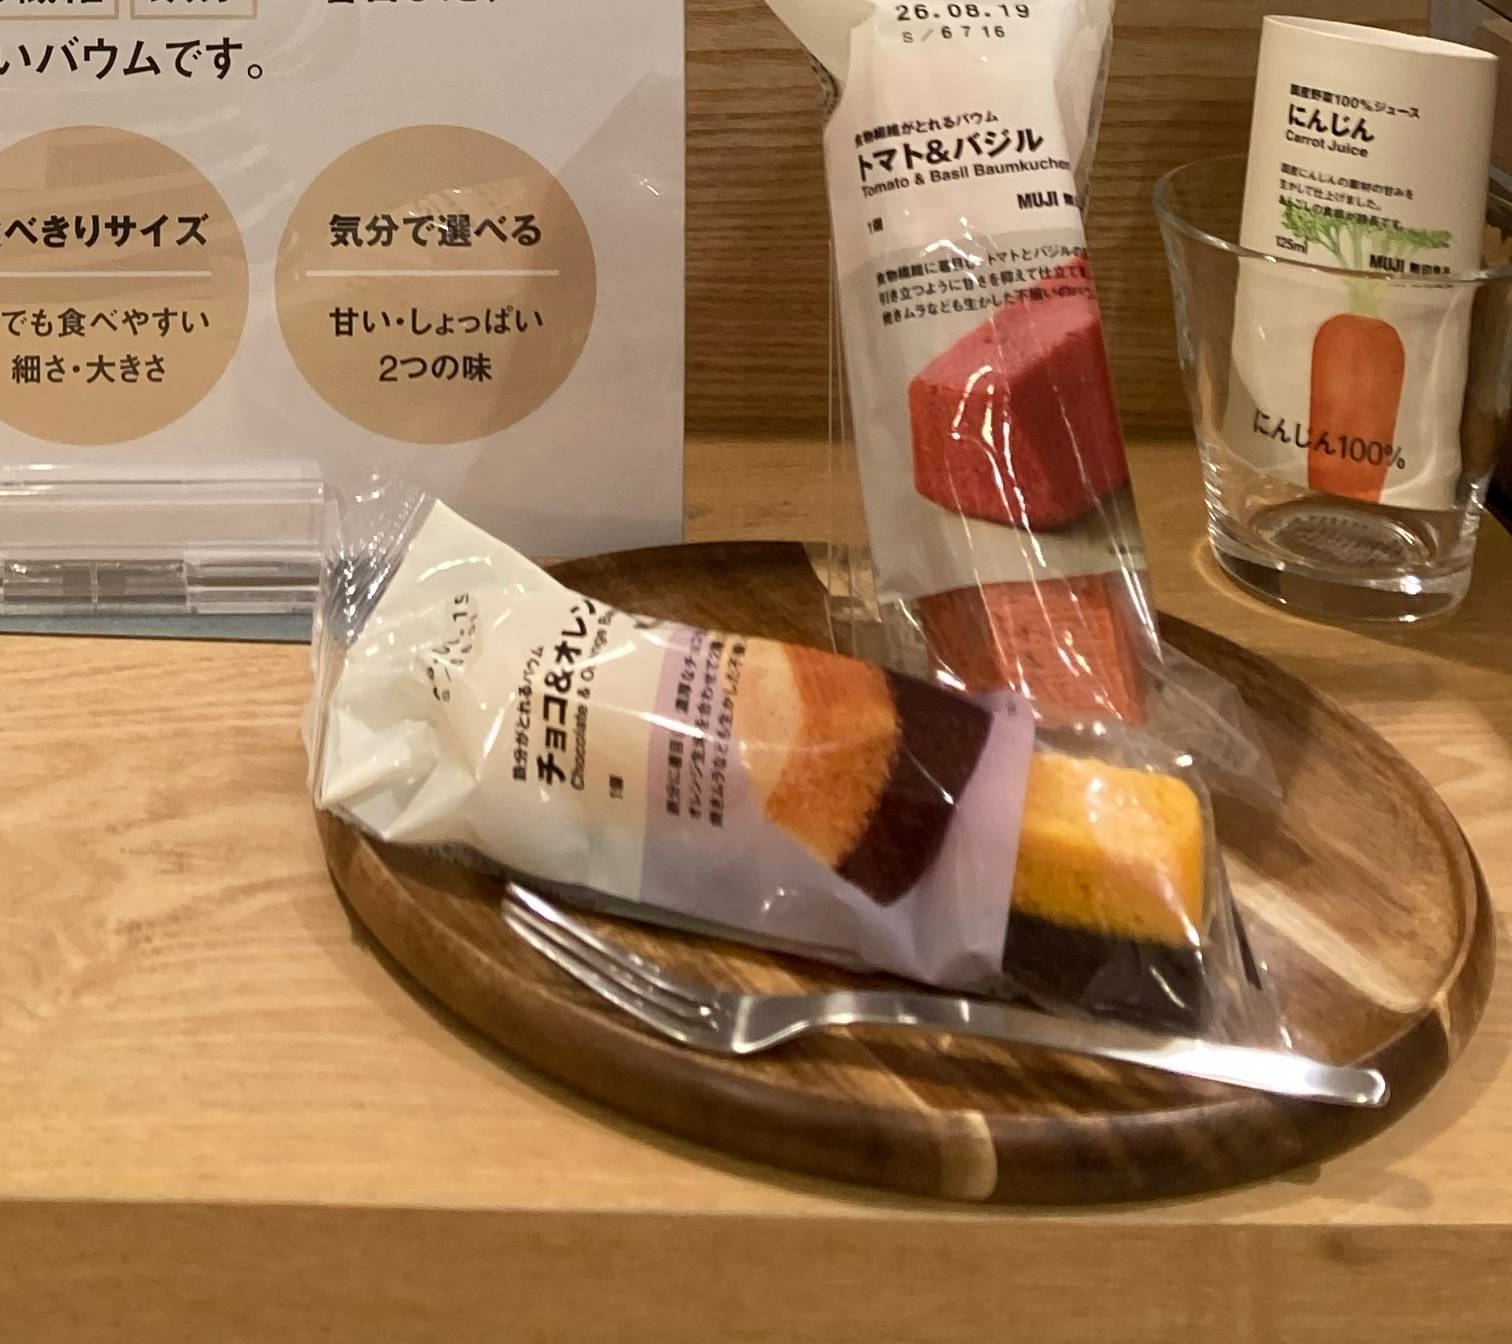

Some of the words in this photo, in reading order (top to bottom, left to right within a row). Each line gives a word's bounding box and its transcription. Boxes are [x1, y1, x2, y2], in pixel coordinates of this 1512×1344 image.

[895, 3, 1030, 22] 26.08.19
[1287, 103, 1375, 143] にんじん
[858, 128, 1044, 183] トマト&バジル
[1286, 129, 1325, 150] Carrot
[1327, 139, 1368, 158] Juice
[861, 178, 910, 198] Tomato
[915, 173, 925, 185] &
[931, 166, 969, 184] Basil
[1017, 191, 1059, 209] MUJI
[327, 213, 544, 250] 気分で選べる
[1370, 254, 1405, 273] MUJI
[328, 303, 545, 336] 甘い・しょっぱい
[10, 350, 168, 385] 細さ・大きさ
[378, 349, 493, 383] 2つの味
[1252, 409, 1406, 470] にんじん100%
